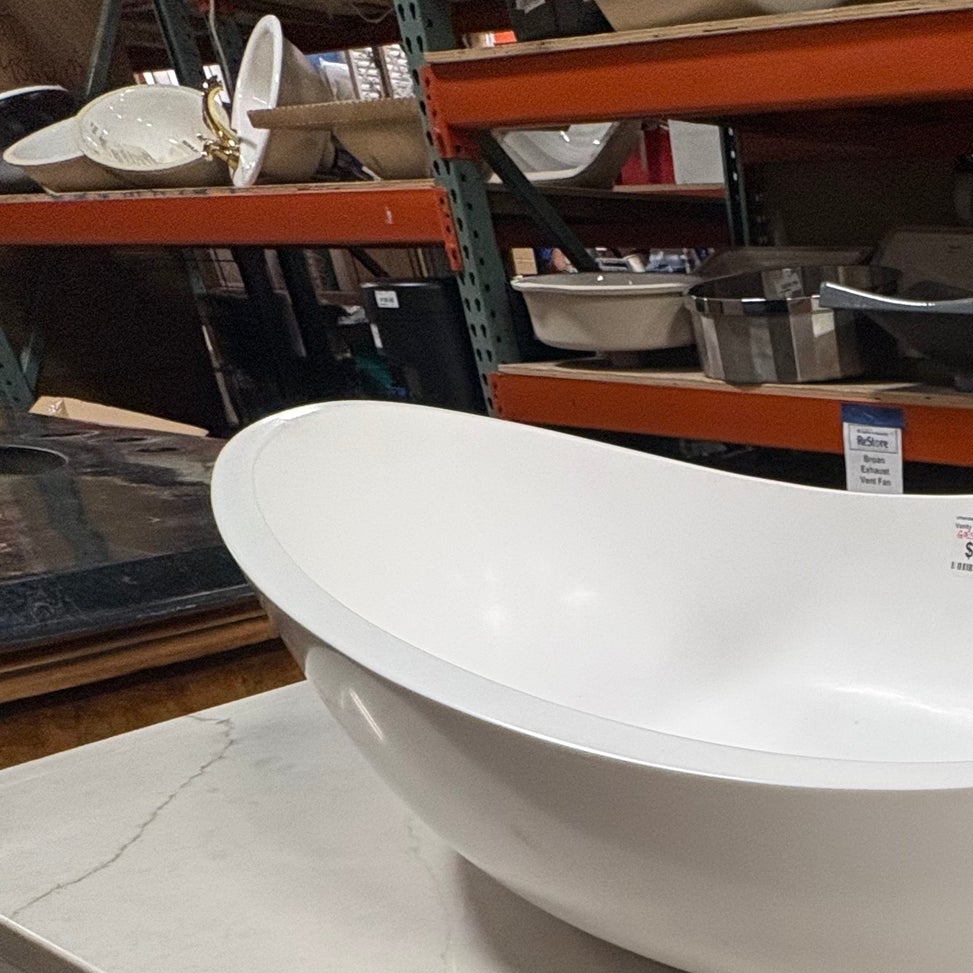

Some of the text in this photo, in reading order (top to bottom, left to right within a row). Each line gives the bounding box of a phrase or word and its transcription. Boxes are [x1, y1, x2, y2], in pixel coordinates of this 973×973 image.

[856, 435, 889, 449] ReStore
[860, 465, 890, 475] Exhaust
[859, 476, 892, 486] Vent Fan
